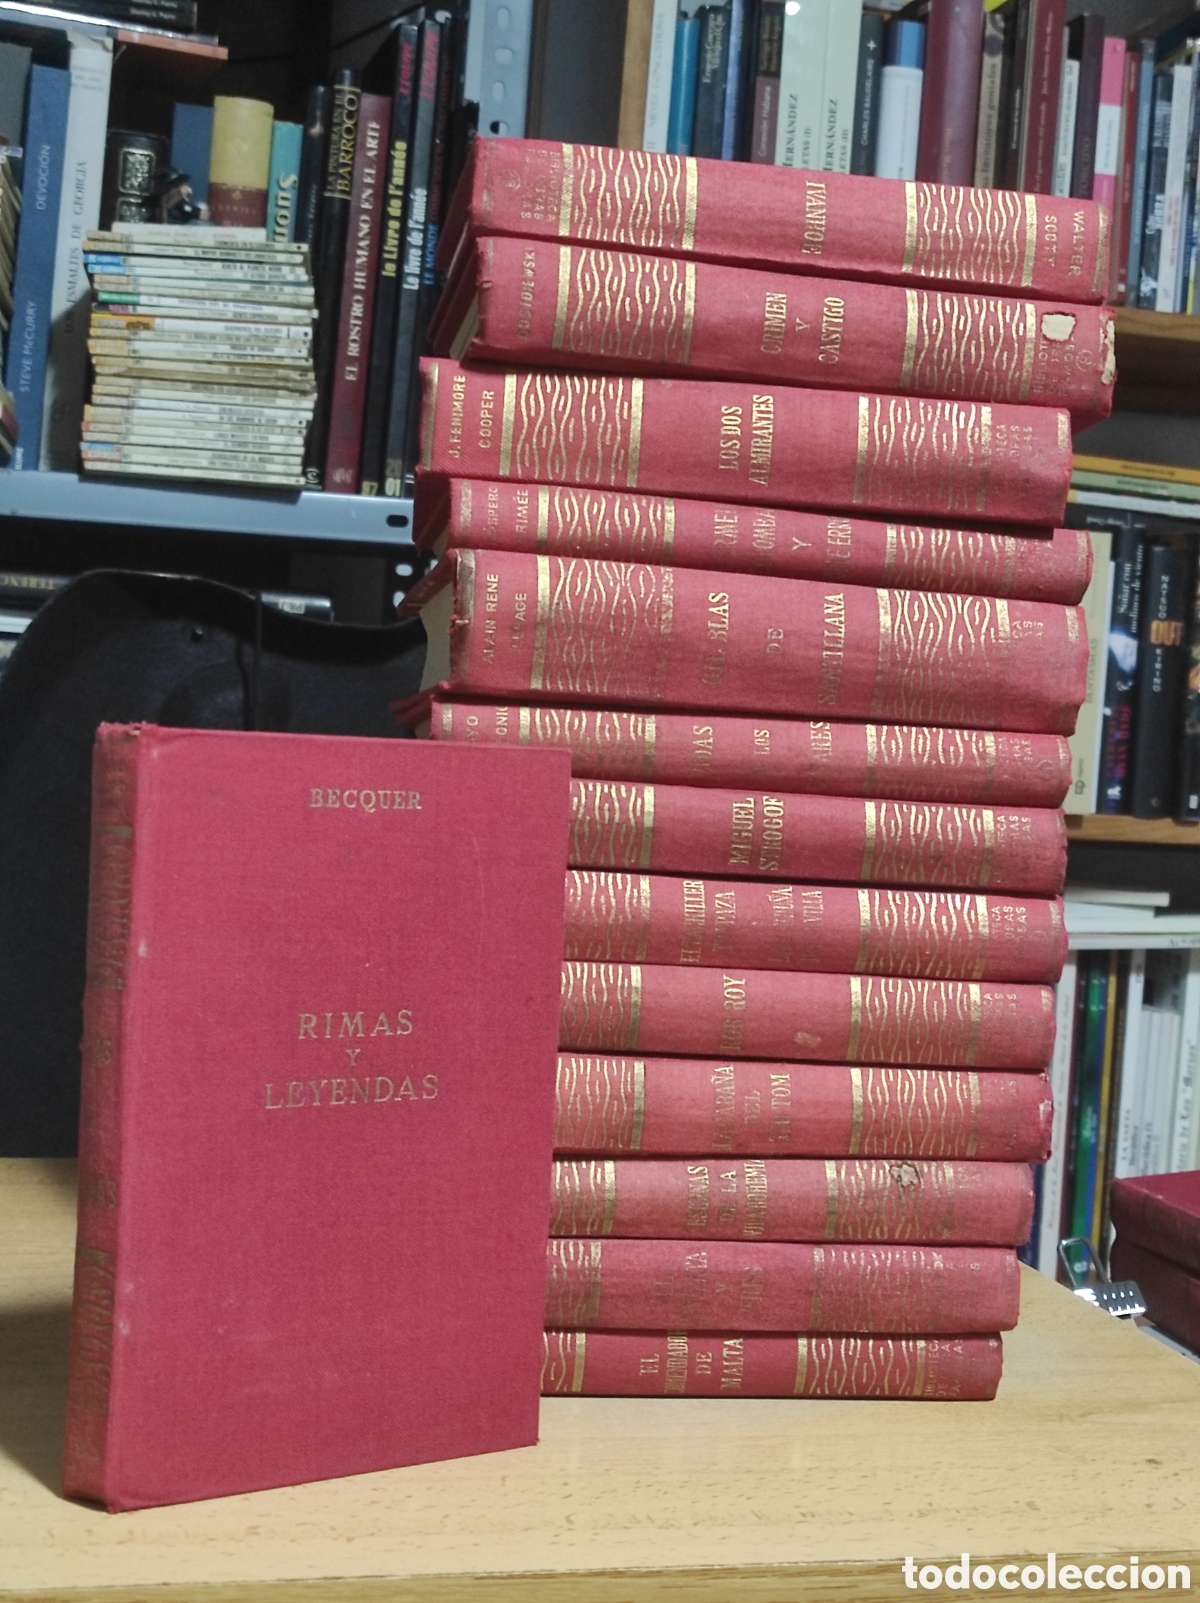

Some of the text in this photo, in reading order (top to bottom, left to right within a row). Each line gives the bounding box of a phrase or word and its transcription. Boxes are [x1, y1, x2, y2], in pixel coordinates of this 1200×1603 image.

[327, 124, 341, 174] PINTURA
[336, 94, 360, 192] BARROCO
[35, 144, 51, 211] DEVOCIÓN
[72, 160, 88, 216] GEORGIA
[359, 187, 374, 210] EN
[362, 165, 377, 184] EL
[70, 223, 82, 239] DE
[387, 199, 402, 217] de
[353, 216, 372, 290] HUMANO
[403, 188, 428, 290] Le livre de l'année
[425, 223, 439, 269] MONDE
[1042, 214, 1057, 267] SCOTT
[1067, 210, 1084, 277] WALTER
[20, 300, 37, 393] STEVE McCURRY
[346, 295, 365, 358] ROSTRO
[761, 291, 789, 356] CRIMEN
[795, 318, 808, 333] Y
[818, 296, 845, 366] CASTIGO
[345, 363, 359, 382] EL
[449, 374, 467, 443] FENIMORE
[477, 391, 495, 449] COOPER
[717, 405, 744, 471] LOS DOS
[747, 394, 775, 488] ALMIRANTES
[791, 536, 813, 551] Y
[1130, 578, 1142, 592] de
[482, 572, 500, 665] ALAIN RENE
[511, 592, 528, 649] LESAGE
[706, 591, 731, 643] BLAS
[765, 627, 785, 655] DE
[817, 592, 847, 706] SANTILLANA
[1152, 647, 1164, 692] KIRINO
[752, 729, 771, 756] LOS
[308, 787, 423, 813] BECQUER
[727, 797, 756, 866] MIGUEL
[758, 795, 785, 871] STROGOF
[722, 972, 747, 1011] ROY
[296, 1009, 415, 1042] RIMAS
[345, 1048, 361, 1067] Y
[263, 1073, 440, 1112] LEYENDAS
[710, 1064, 736, 1127] CABAÑA
[743, 1090, 762, 1124] DEL
[769, 1073, 792, 1109] TOM
[718, 1169, 738, 1193] LA
[638, 1352, 660, 1376] EL
[695, 1350, 713, 1376] DE
[719, 1337, 745, 1390] MALTA
